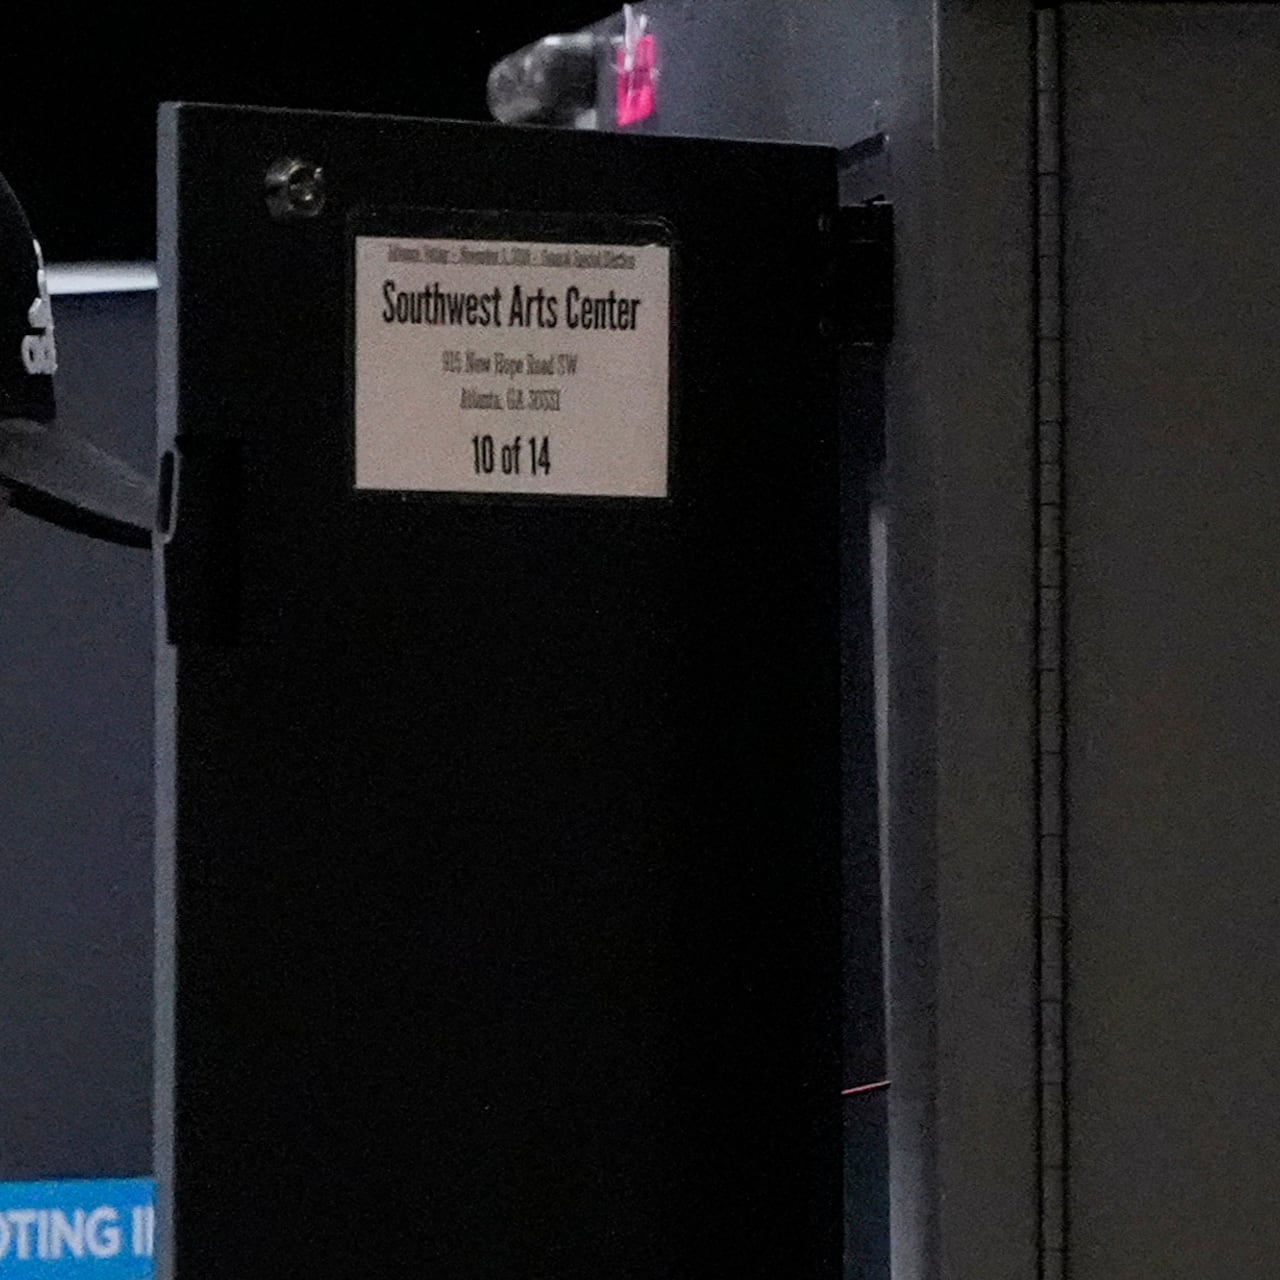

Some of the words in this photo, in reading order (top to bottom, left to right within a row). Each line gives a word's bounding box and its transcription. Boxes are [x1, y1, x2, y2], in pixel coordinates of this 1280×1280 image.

[382, 279, 502, 328] Southwest
[508, 284, 558, 330] Arts
[565, 285, 642, 331] Center
[556, 353, 578, 376] SW
[471, 434, 495, 475] 10
[501, 435, 522, 476] of
[528, 435, 551, 477] 14
